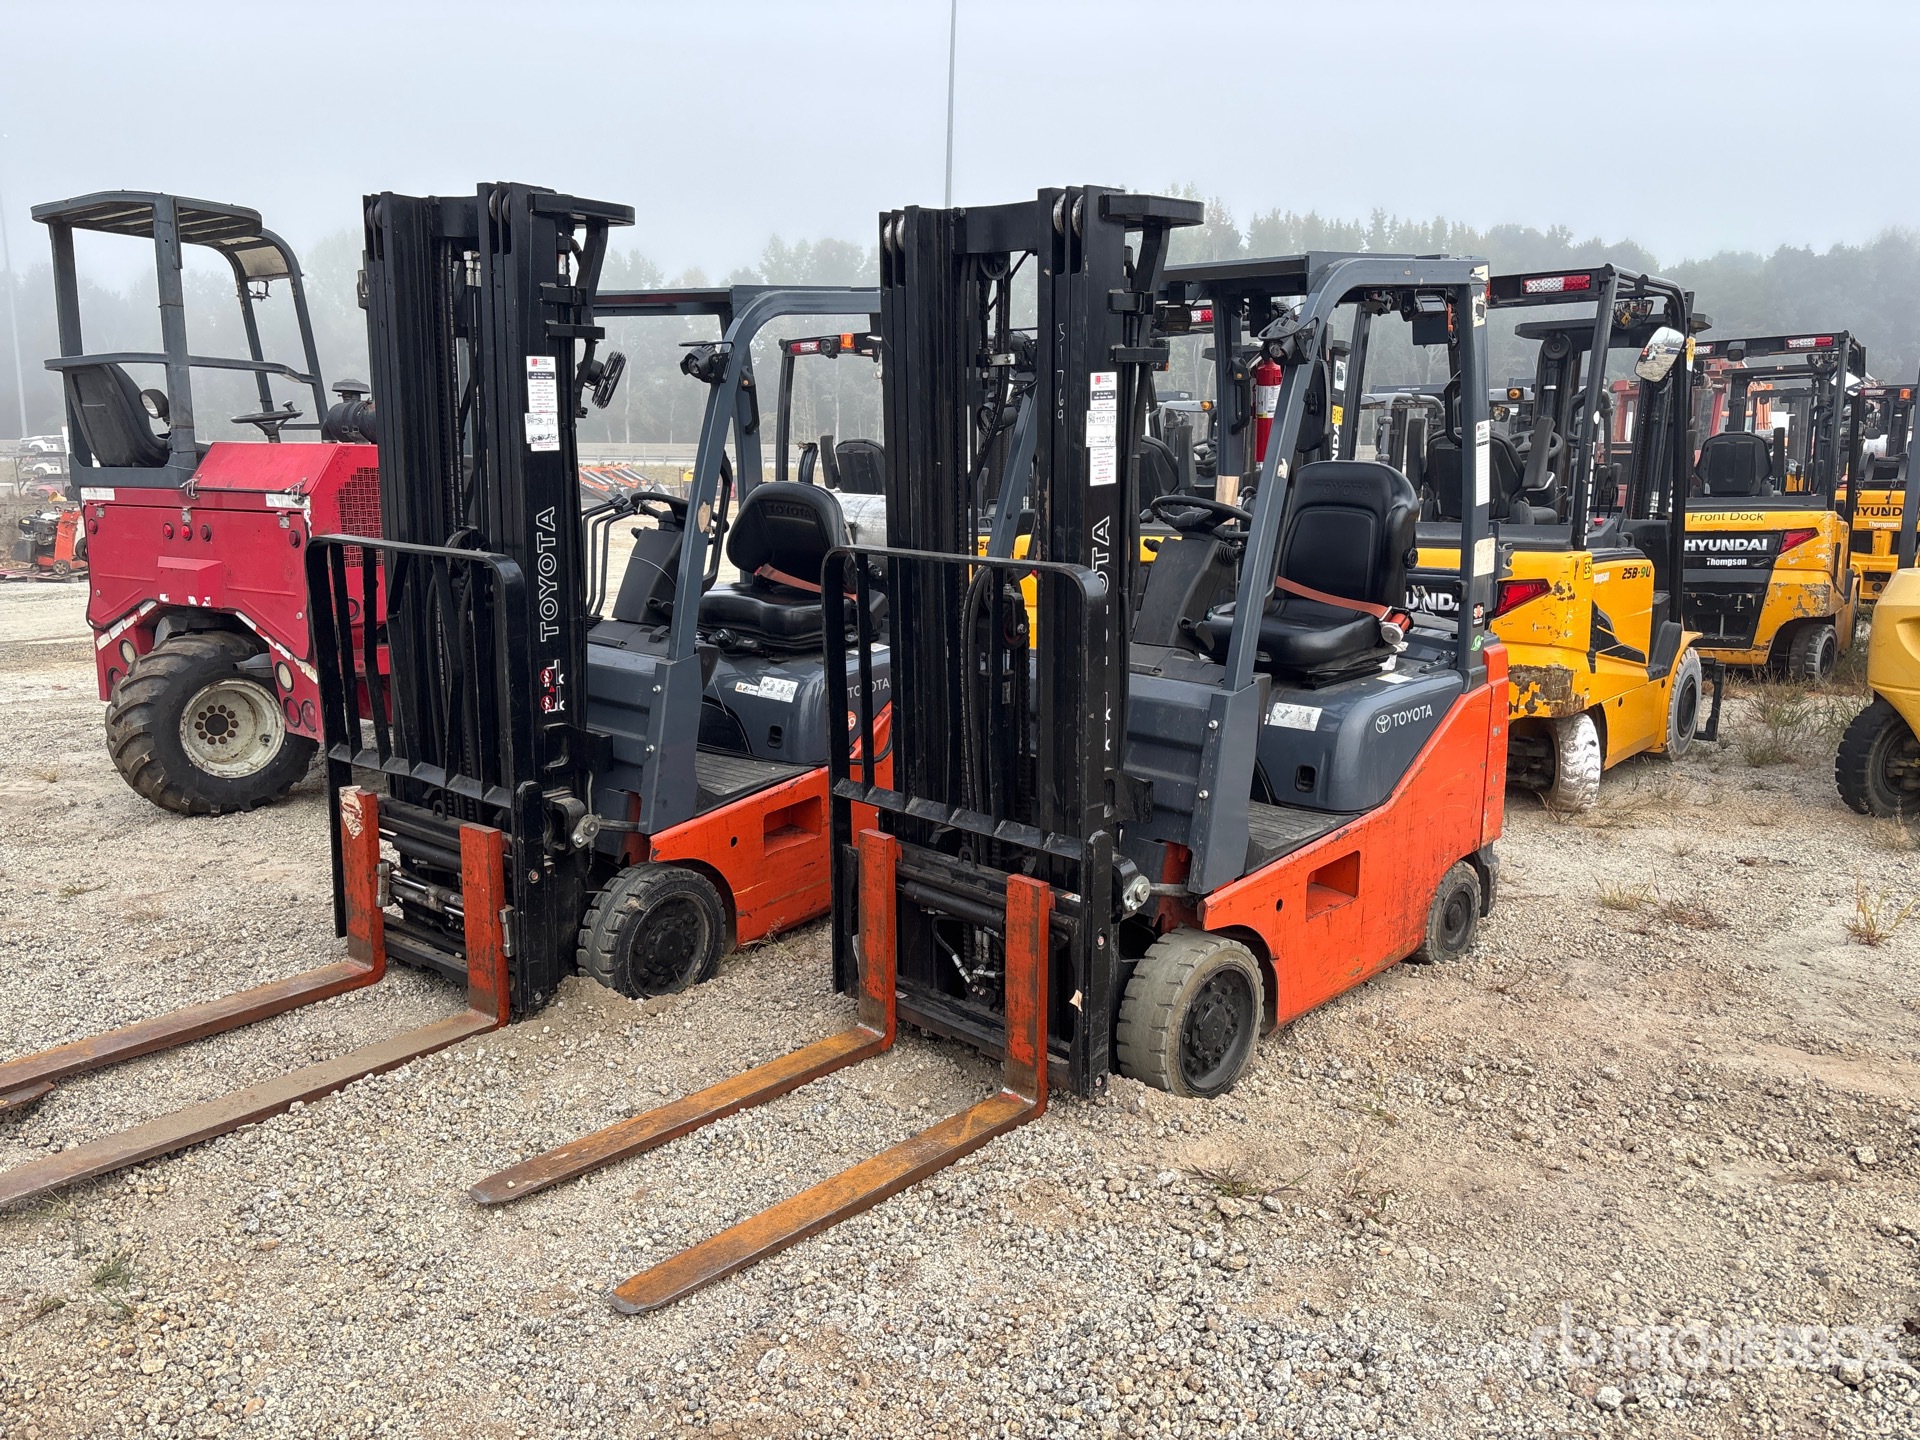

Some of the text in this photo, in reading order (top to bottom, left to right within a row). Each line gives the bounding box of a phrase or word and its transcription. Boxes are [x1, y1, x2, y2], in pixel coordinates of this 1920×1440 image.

[1314, 481, 1372, 497] TOYOTA
[770, 503, 813, 519] TOYOTA
[1691, 512, 1764, 522] Front Dock
[1868, 521, 1899, 529] Thompson
[1683, 538, 1768, 552] HYUNDAI
[1706, 557, 1748, 567] Thompson
[535, 505, 560, 643] TOYOTA
[1621, 565, 1652, 580] 25B-9U
[1392, 703, 1433, 728] TOYOTA
